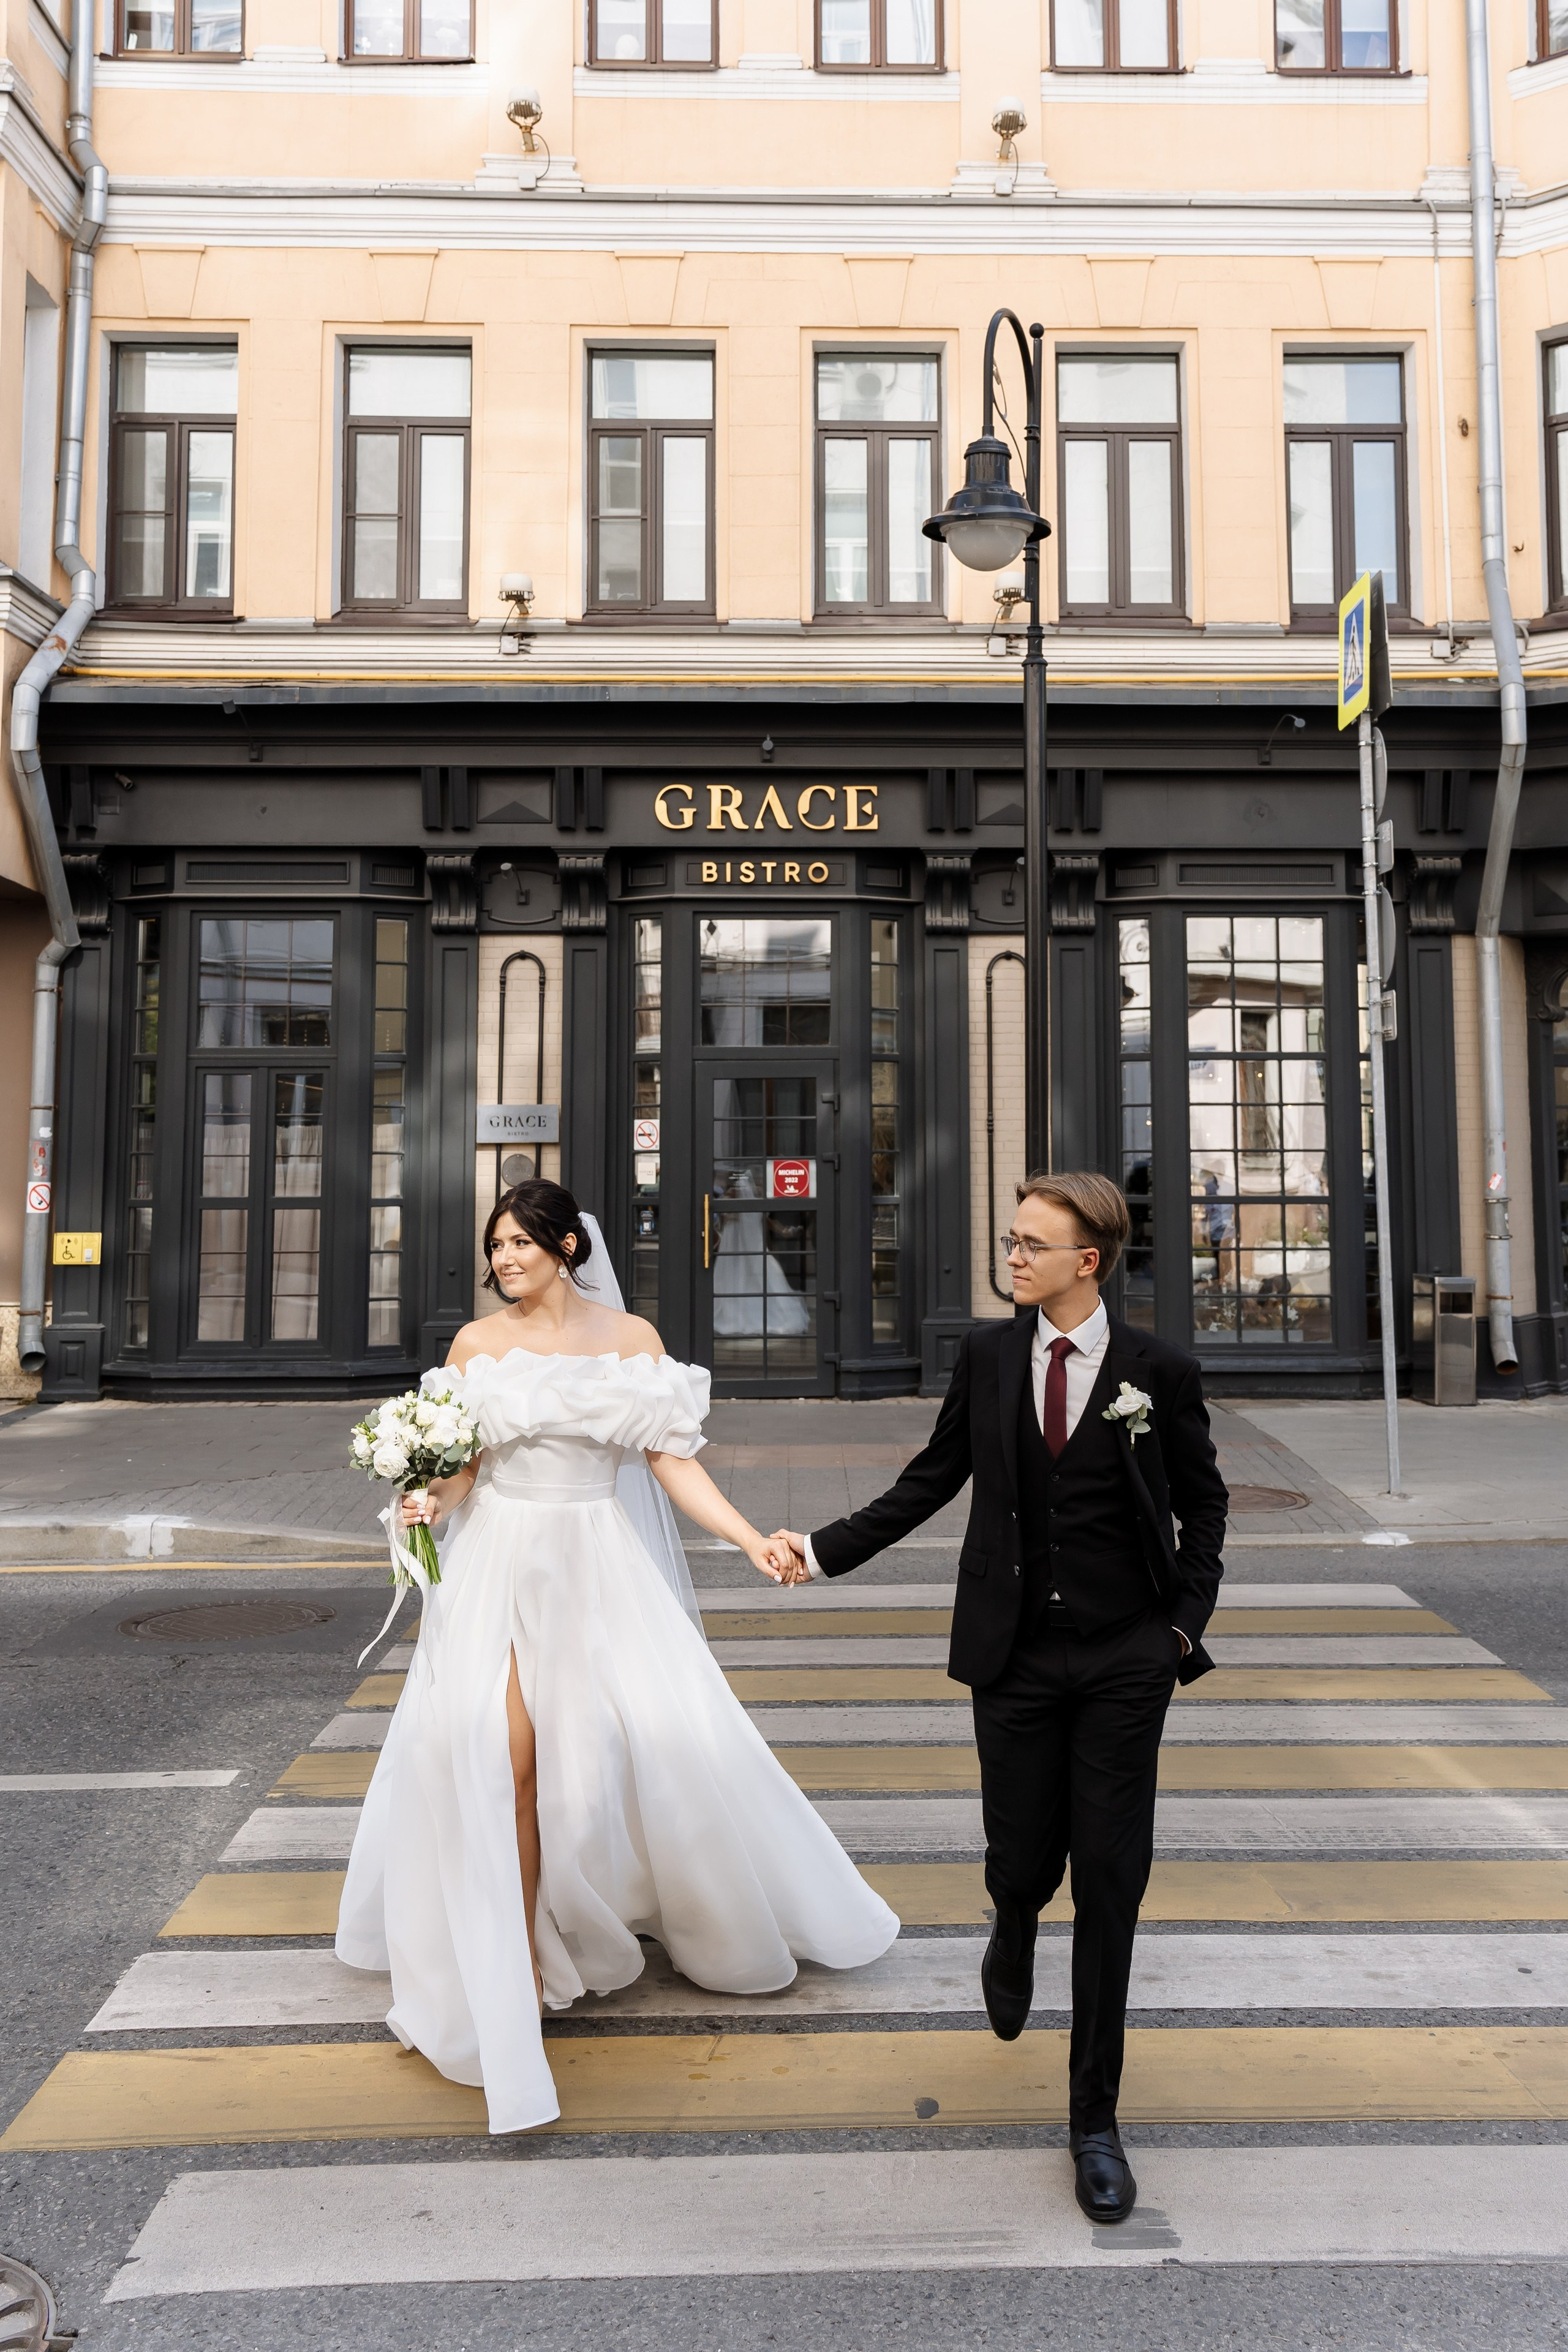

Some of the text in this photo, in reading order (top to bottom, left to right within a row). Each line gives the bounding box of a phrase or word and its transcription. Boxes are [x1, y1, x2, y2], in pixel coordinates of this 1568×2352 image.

[654, 783, 879, 831] GRACE
[701, 861, 829, 884] BISTRO
[489, 1115, 547, 1128] GRACE
